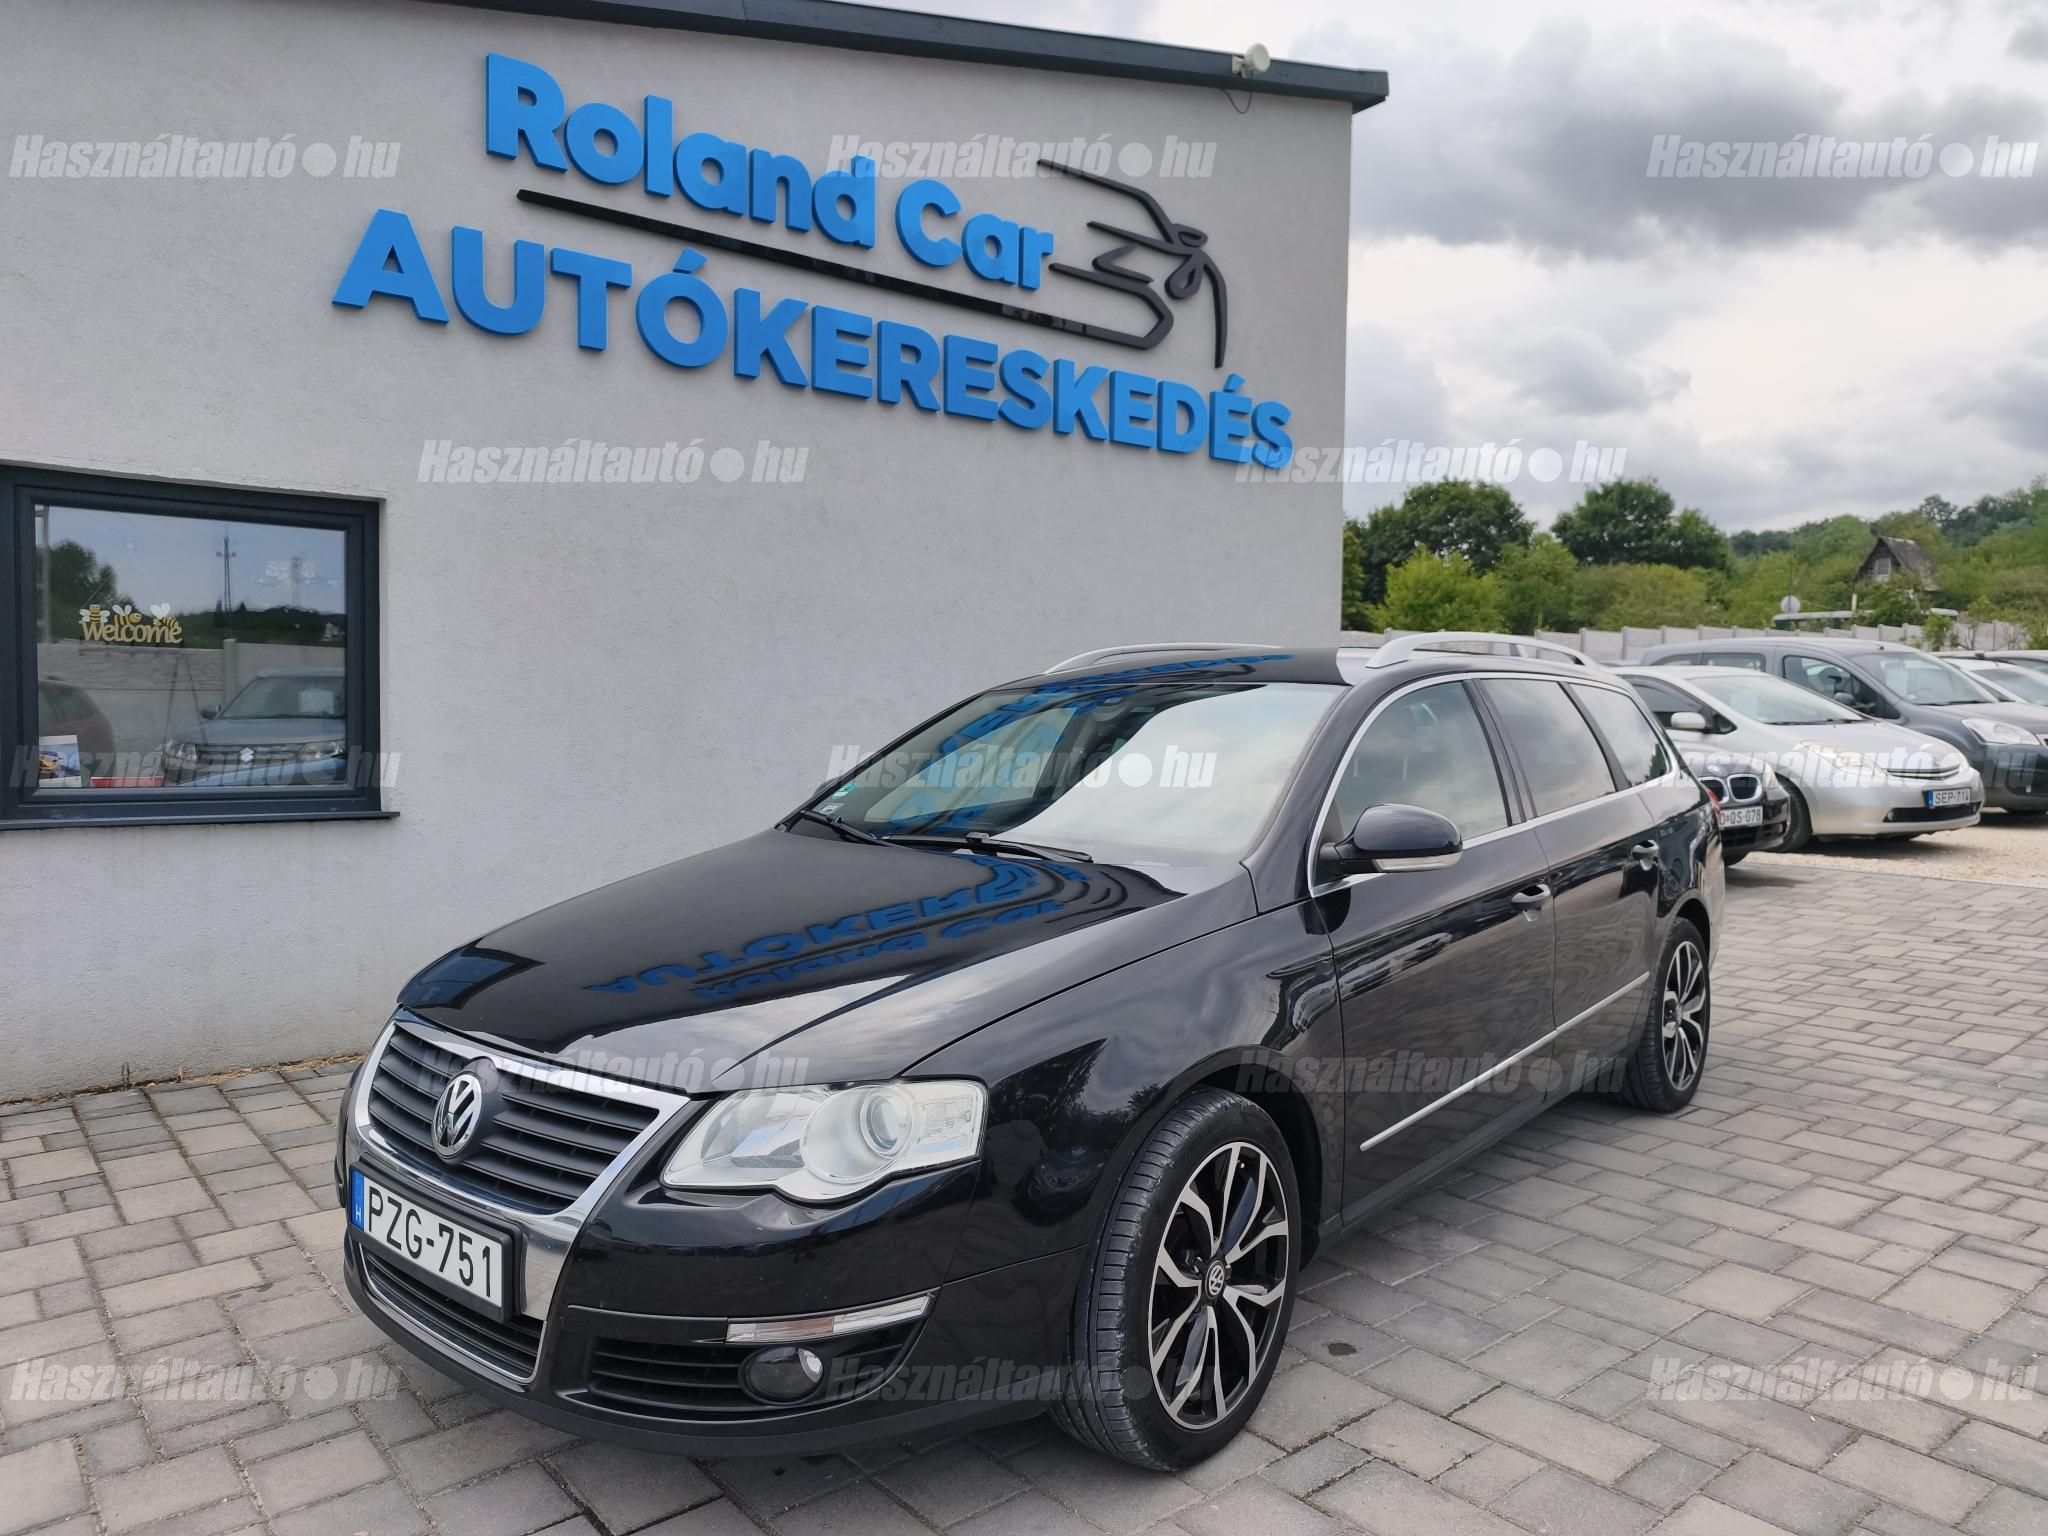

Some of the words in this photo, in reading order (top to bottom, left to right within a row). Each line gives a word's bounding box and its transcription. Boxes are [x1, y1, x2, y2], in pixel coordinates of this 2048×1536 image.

[486, 52, 875, 249] Roland
[896, 178, 1054, 291] Car
[332, 208, 1294, 471] AUTÓKERESKEDÉS
[79, 618, 183, 644] Welcome
[355, 1206, 362, 1223] H
[368, 1185, 491, 1298] PZG-751
